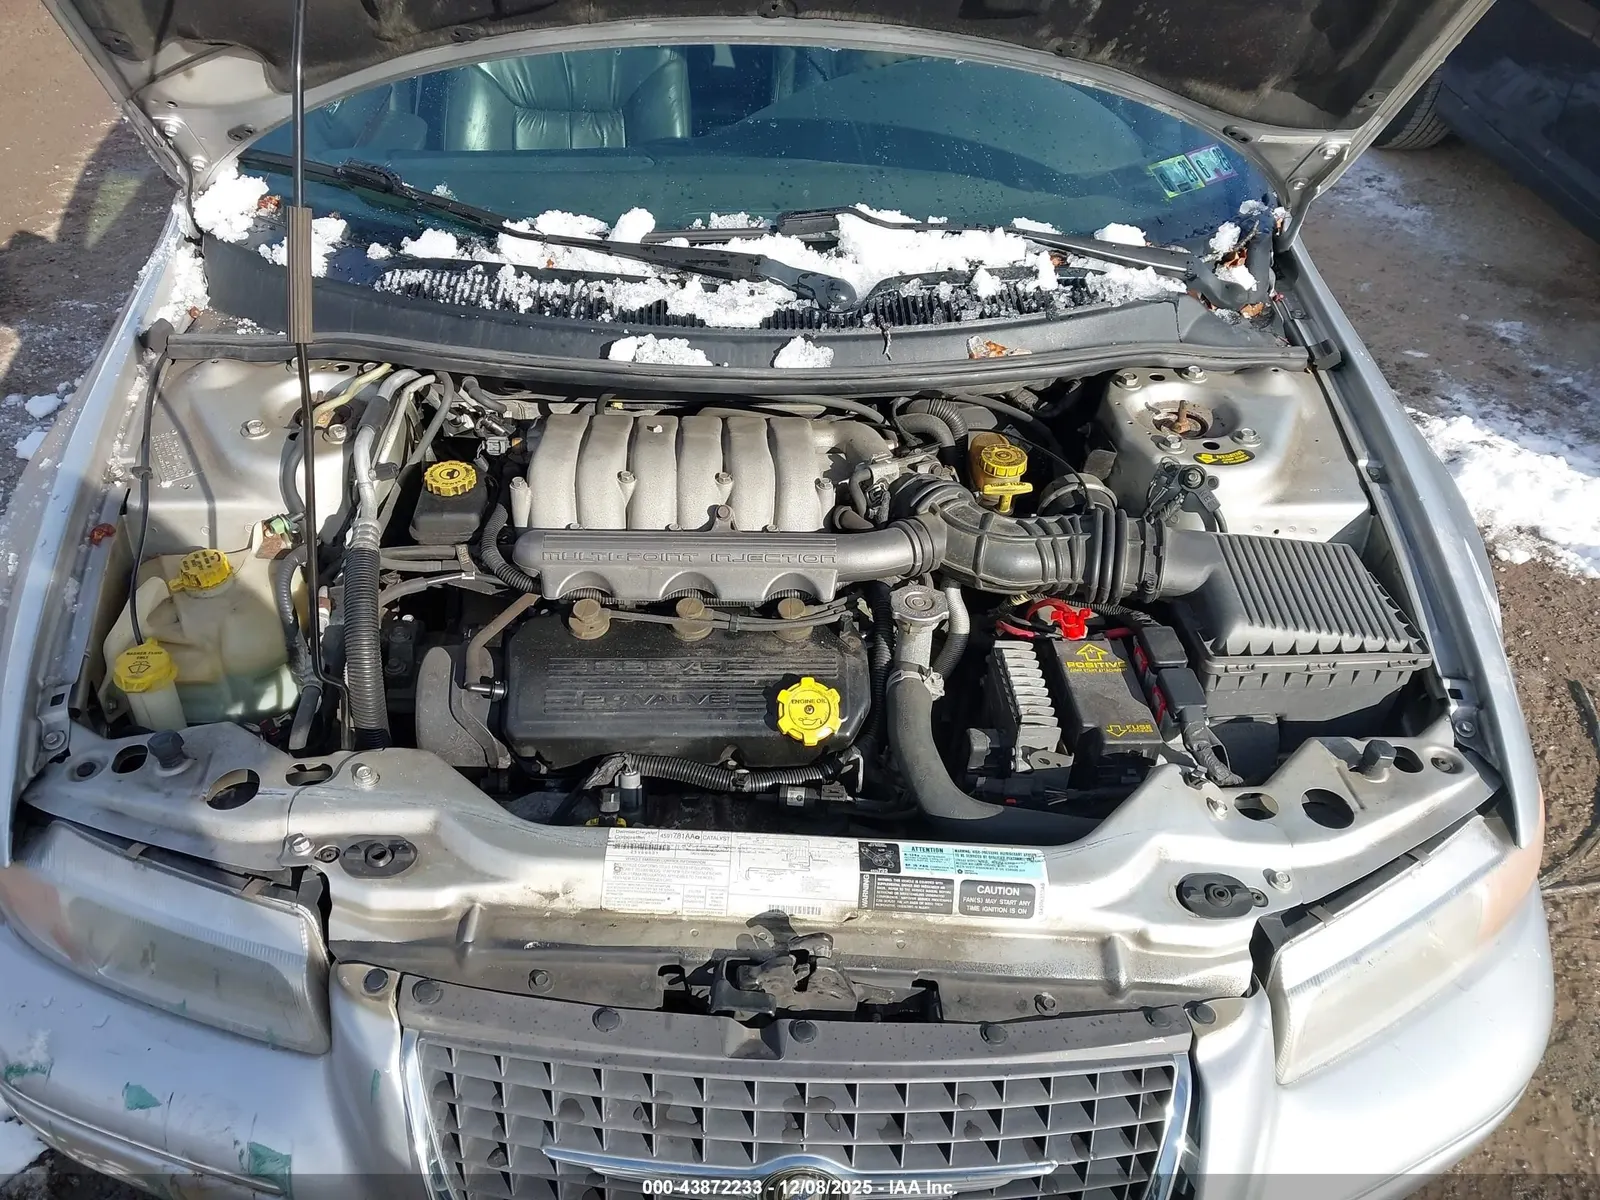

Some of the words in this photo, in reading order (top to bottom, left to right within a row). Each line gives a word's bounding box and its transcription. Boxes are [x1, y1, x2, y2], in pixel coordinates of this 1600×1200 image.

[542, 551, 699, 562] MULTI-POINT
[710, 552, 837, 564] INJECTION
[862, 874, 870, 908] WARNING
[977, 885, 1020, 896] CAUTION
